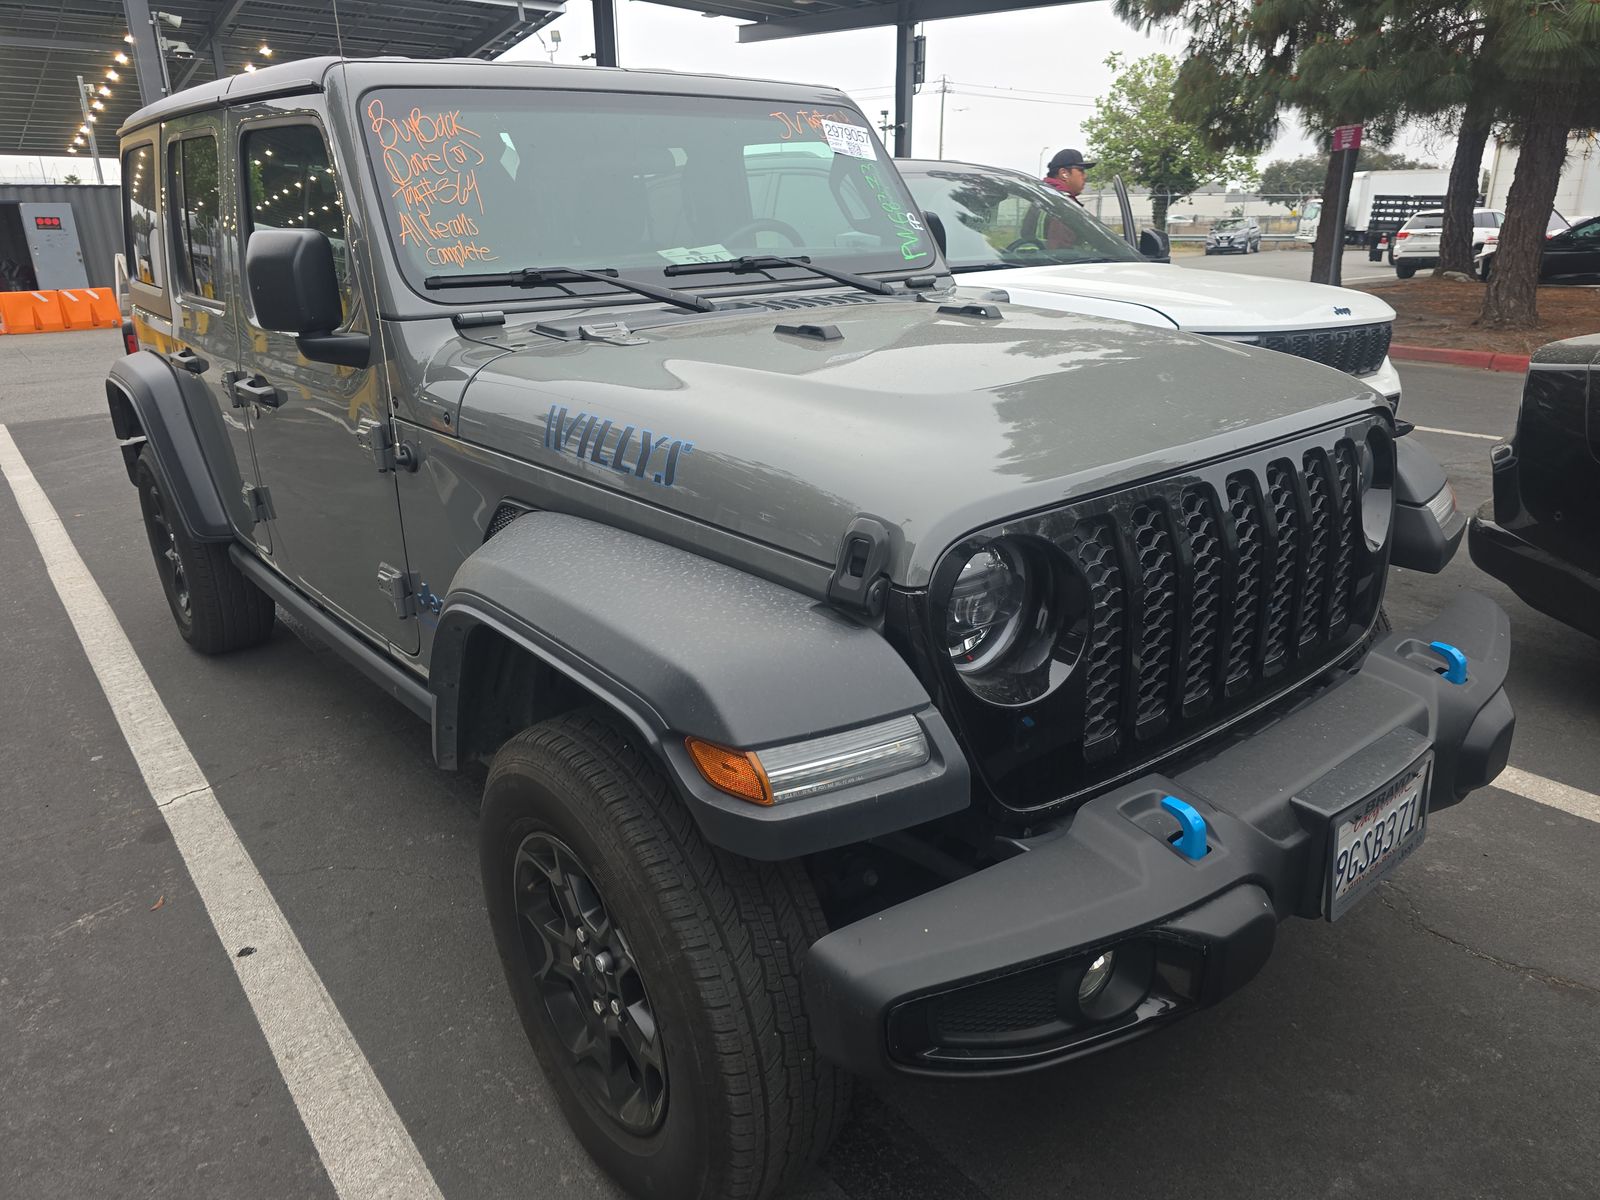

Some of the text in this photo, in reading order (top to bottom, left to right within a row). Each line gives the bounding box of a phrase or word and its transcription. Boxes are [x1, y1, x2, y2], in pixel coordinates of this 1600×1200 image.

[383, 146, 448, 186] Done
[399, 211, 421, 248] All
[544, 404, 693, 487] WILLYS
[1336, 793, 1418, 891] 9GSB371
